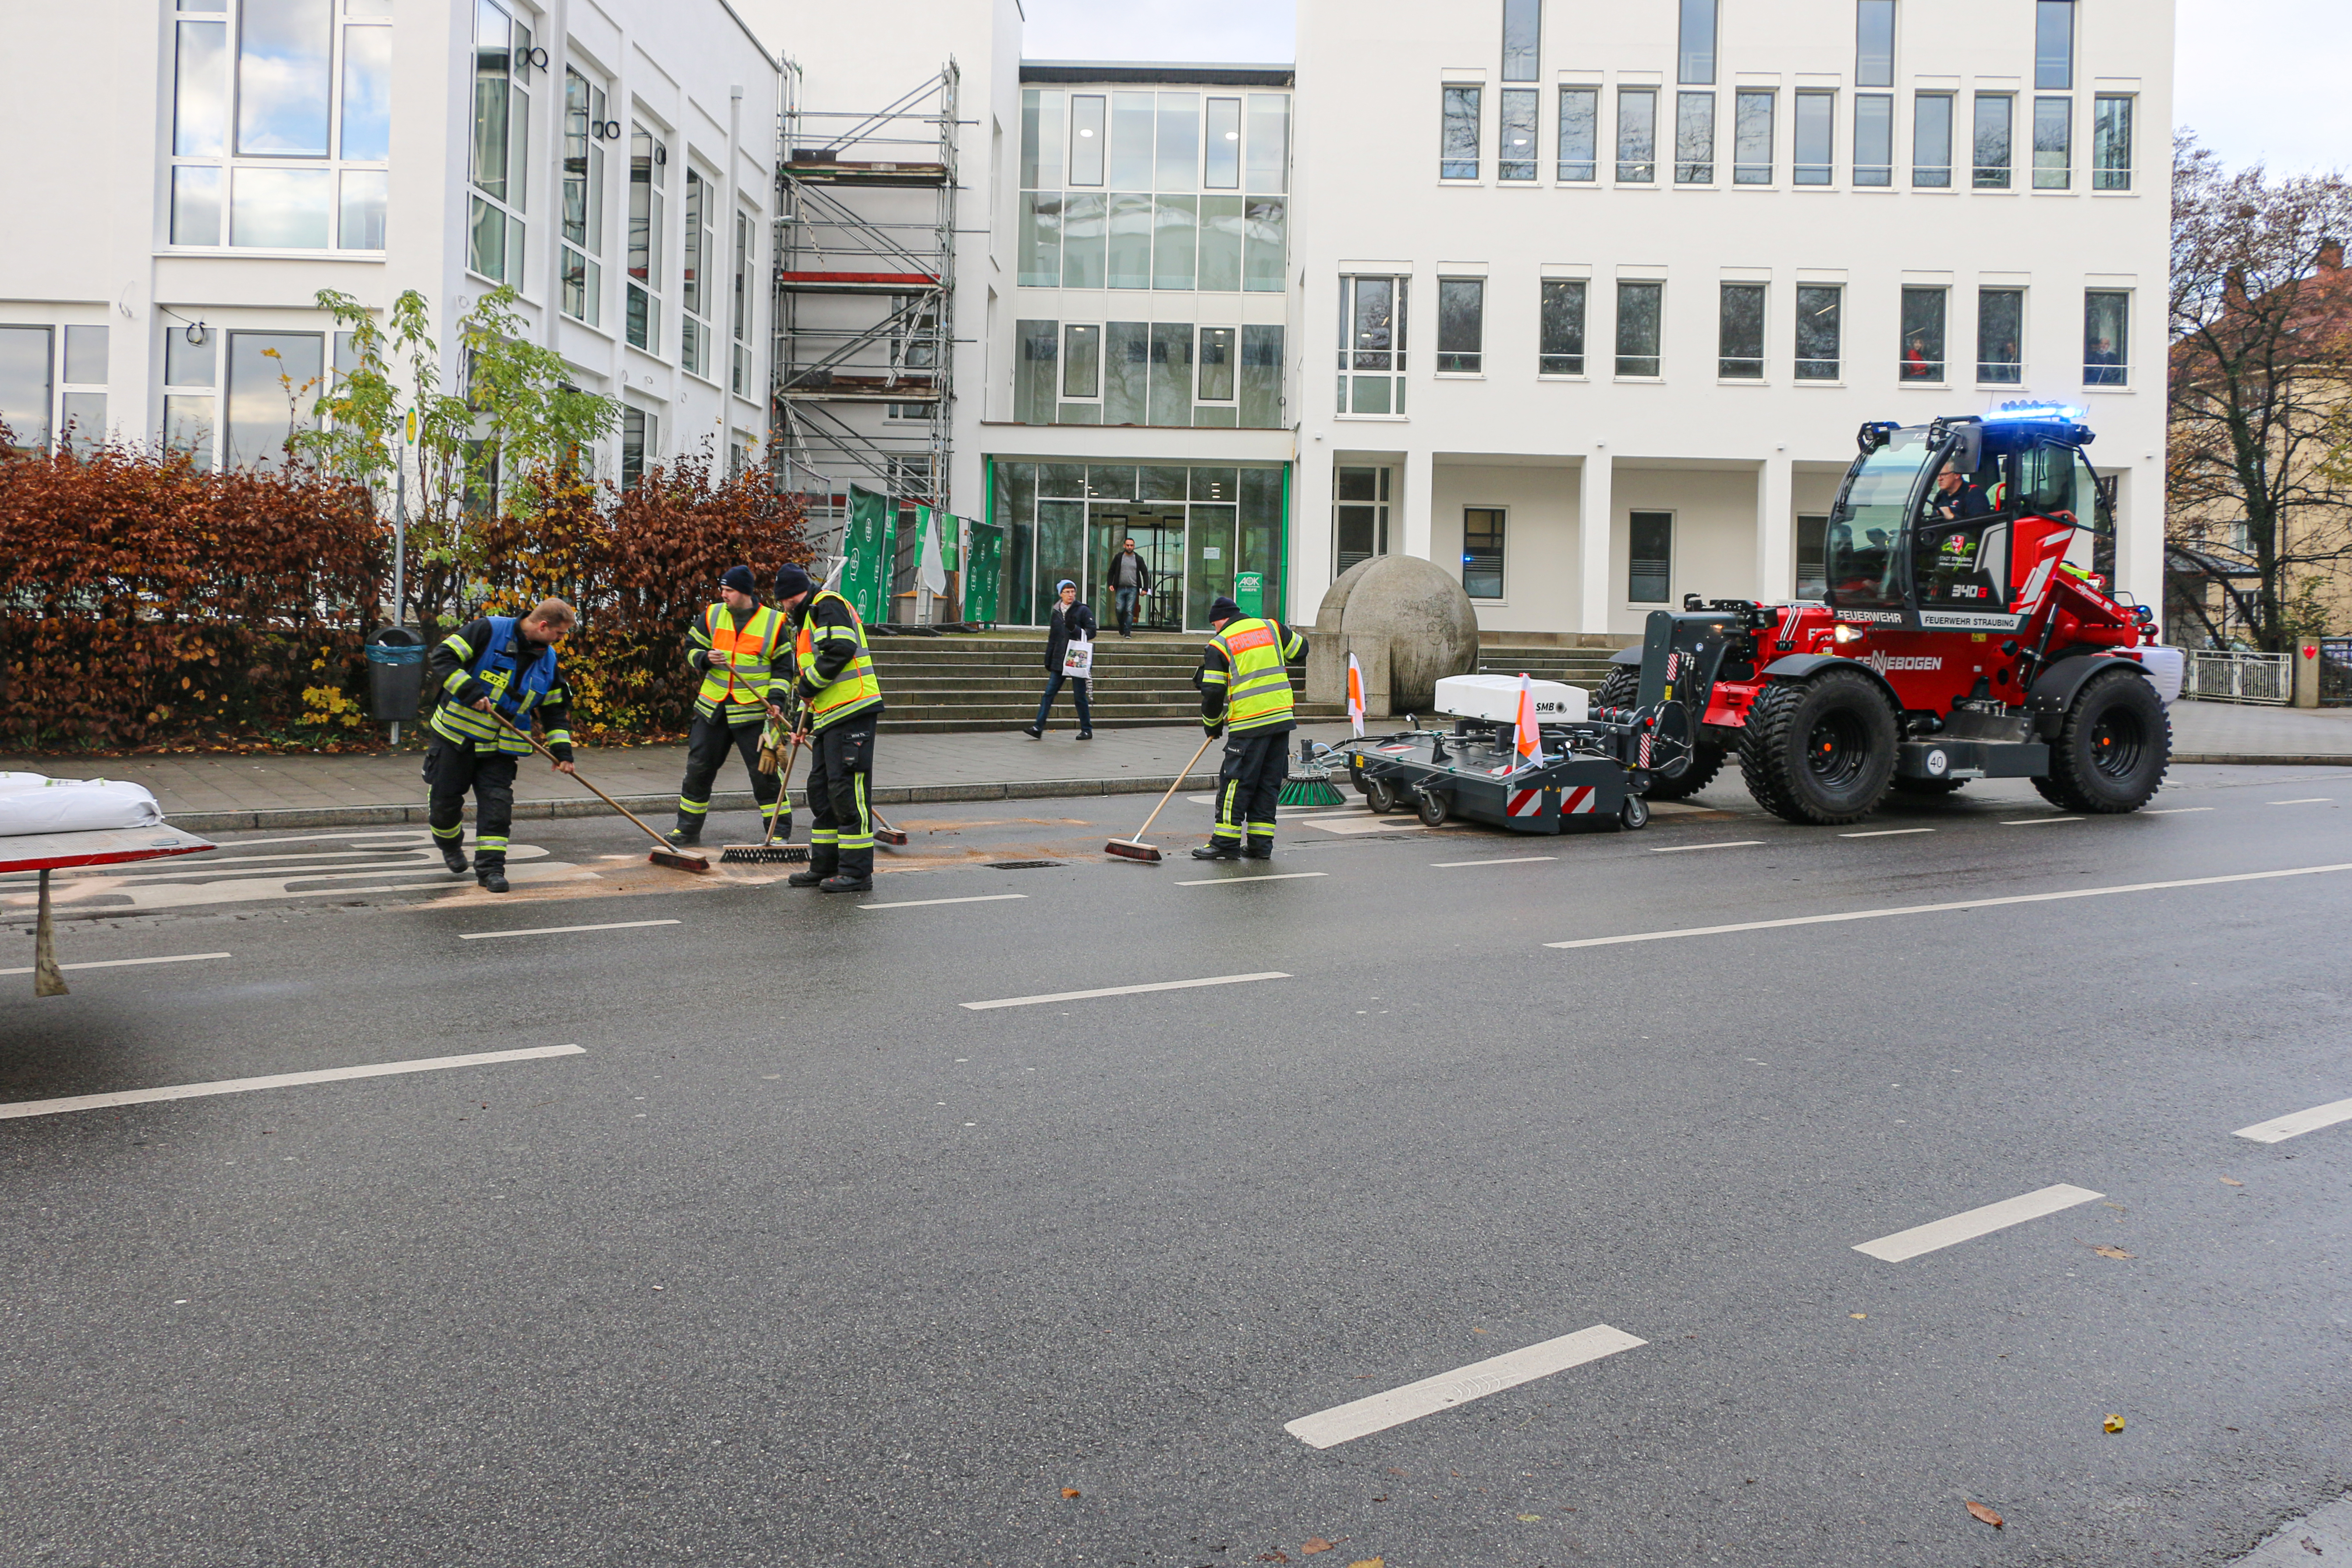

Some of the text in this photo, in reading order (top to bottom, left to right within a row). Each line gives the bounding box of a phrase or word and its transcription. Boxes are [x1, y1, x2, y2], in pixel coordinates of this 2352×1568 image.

[1238, 577, 1260, 585] AOK
[1952, 584, 1988, 598] 340G
[1837, 610, 1902, 623] FEUERWEHR
[1925, 616, 2014, 627] FEUERWEHR STRAUBING
[1227, 628, 1274, 653] FEUERWEHR
[482, 672, 507, 687] 1.47.1
[1536, 702, 1554, 711] SMB
[1930, 756, 1943, 767] 40
